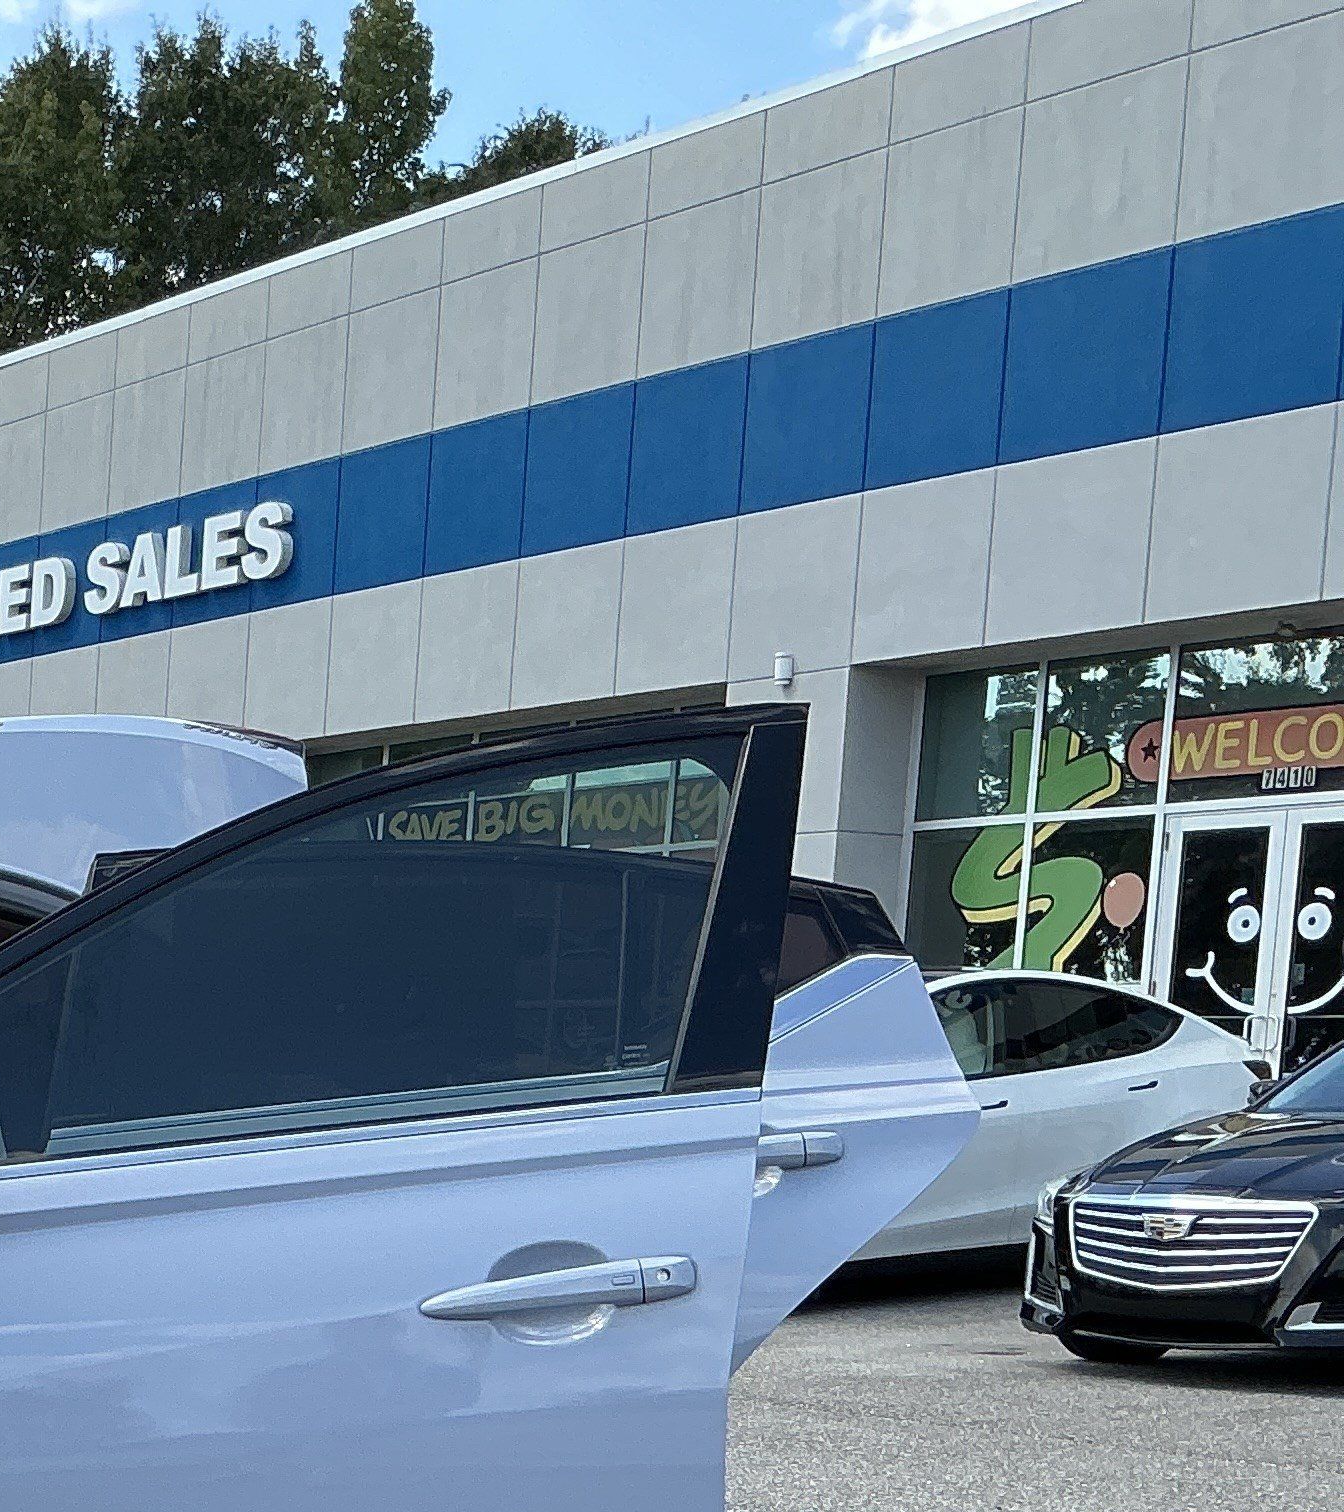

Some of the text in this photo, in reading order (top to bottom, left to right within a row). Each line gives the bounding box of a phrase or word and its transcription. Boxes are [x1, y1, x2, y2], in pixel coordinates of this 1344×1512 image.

[84, 501, 294, 615] SALES
[1172, 712, 1344, 774] WELCO
[1263, 765, 1315, 790] 7410
[388, 781, 720, 842] SAVE BIG MONEY
